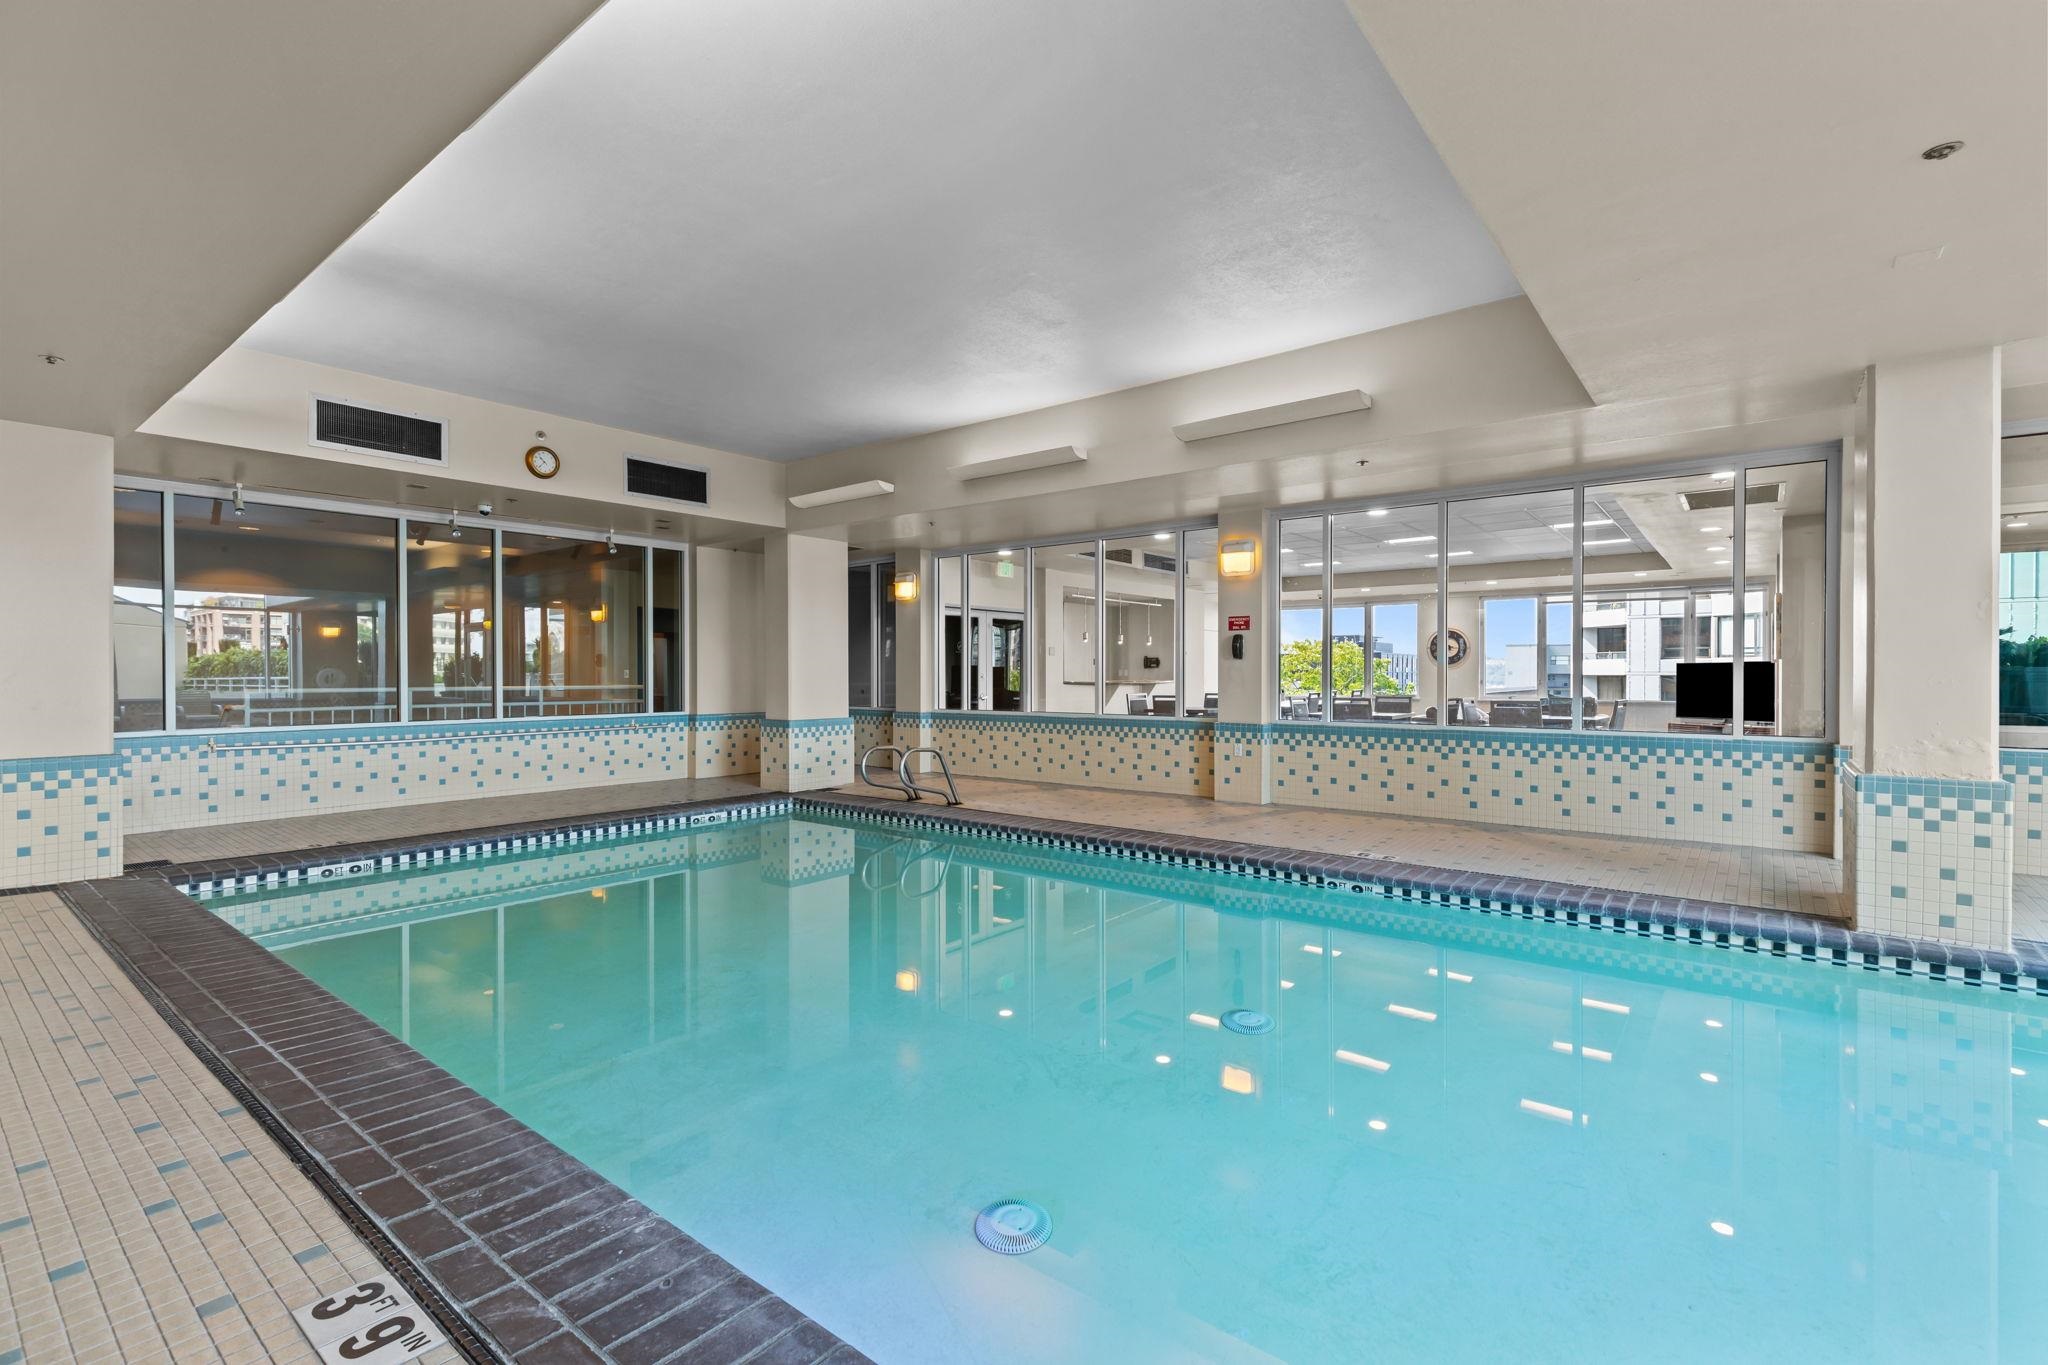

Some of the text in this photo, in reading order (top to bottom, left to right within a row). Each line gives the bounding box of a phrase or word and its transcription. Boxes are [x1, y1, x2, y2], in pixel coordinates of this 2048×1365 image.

[311, 1282, 431, 1359] 3 FT 9 IN
